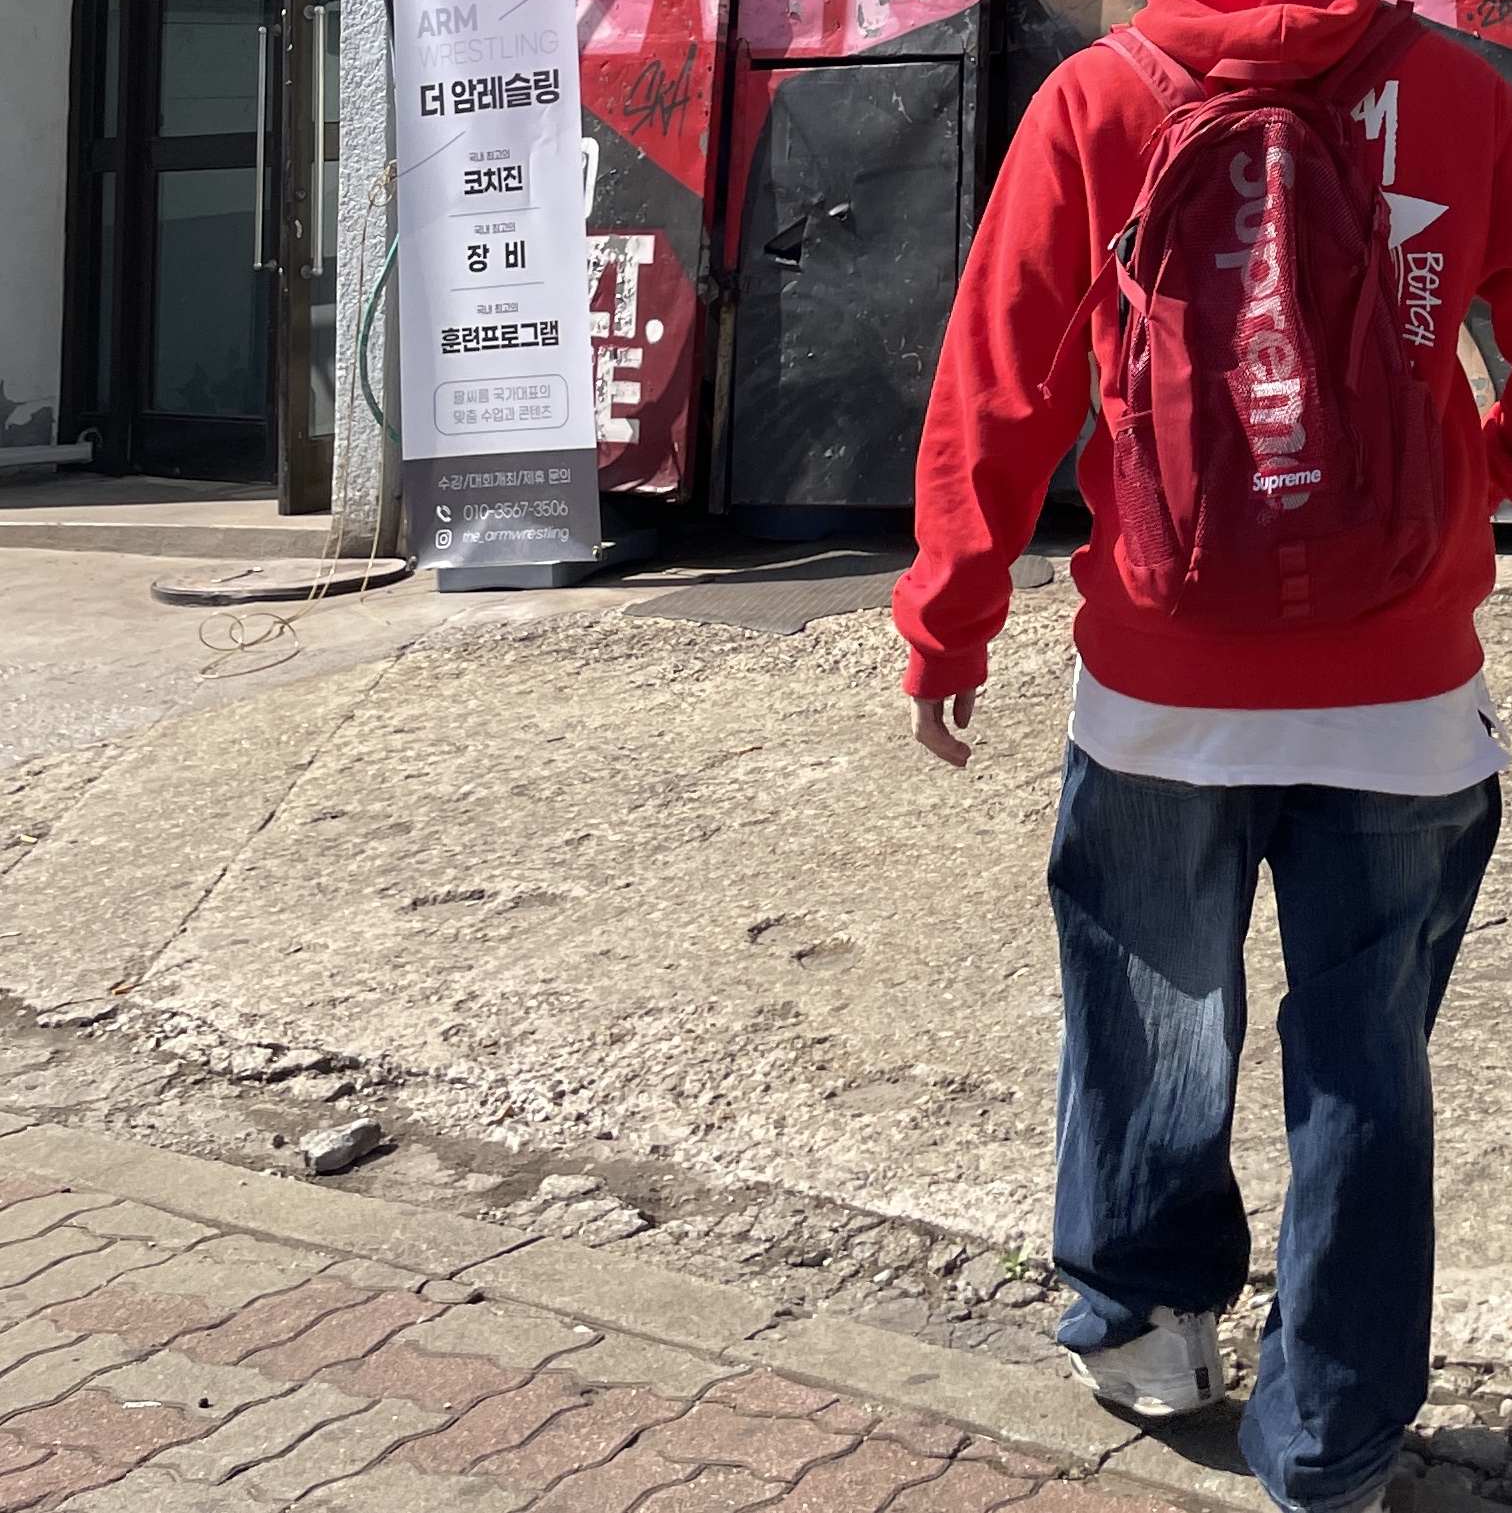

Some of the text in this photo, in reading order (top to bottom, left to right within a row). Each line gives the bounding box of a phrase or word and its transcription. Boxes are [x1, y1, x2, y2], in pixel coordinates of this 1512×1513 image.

[417, 4, 478, 38] ARM
[417, 29, 559, 69] WRESTLING
[420, 69, 560, 116] 더 암레슬링
[464, 165, 523, 195] 코치진
[441, 320, 559, 354] 훈련프로그램
[1252, 469, 1322, 494] Supreme
[463, 500, 569, 521] 010-3567-3506
